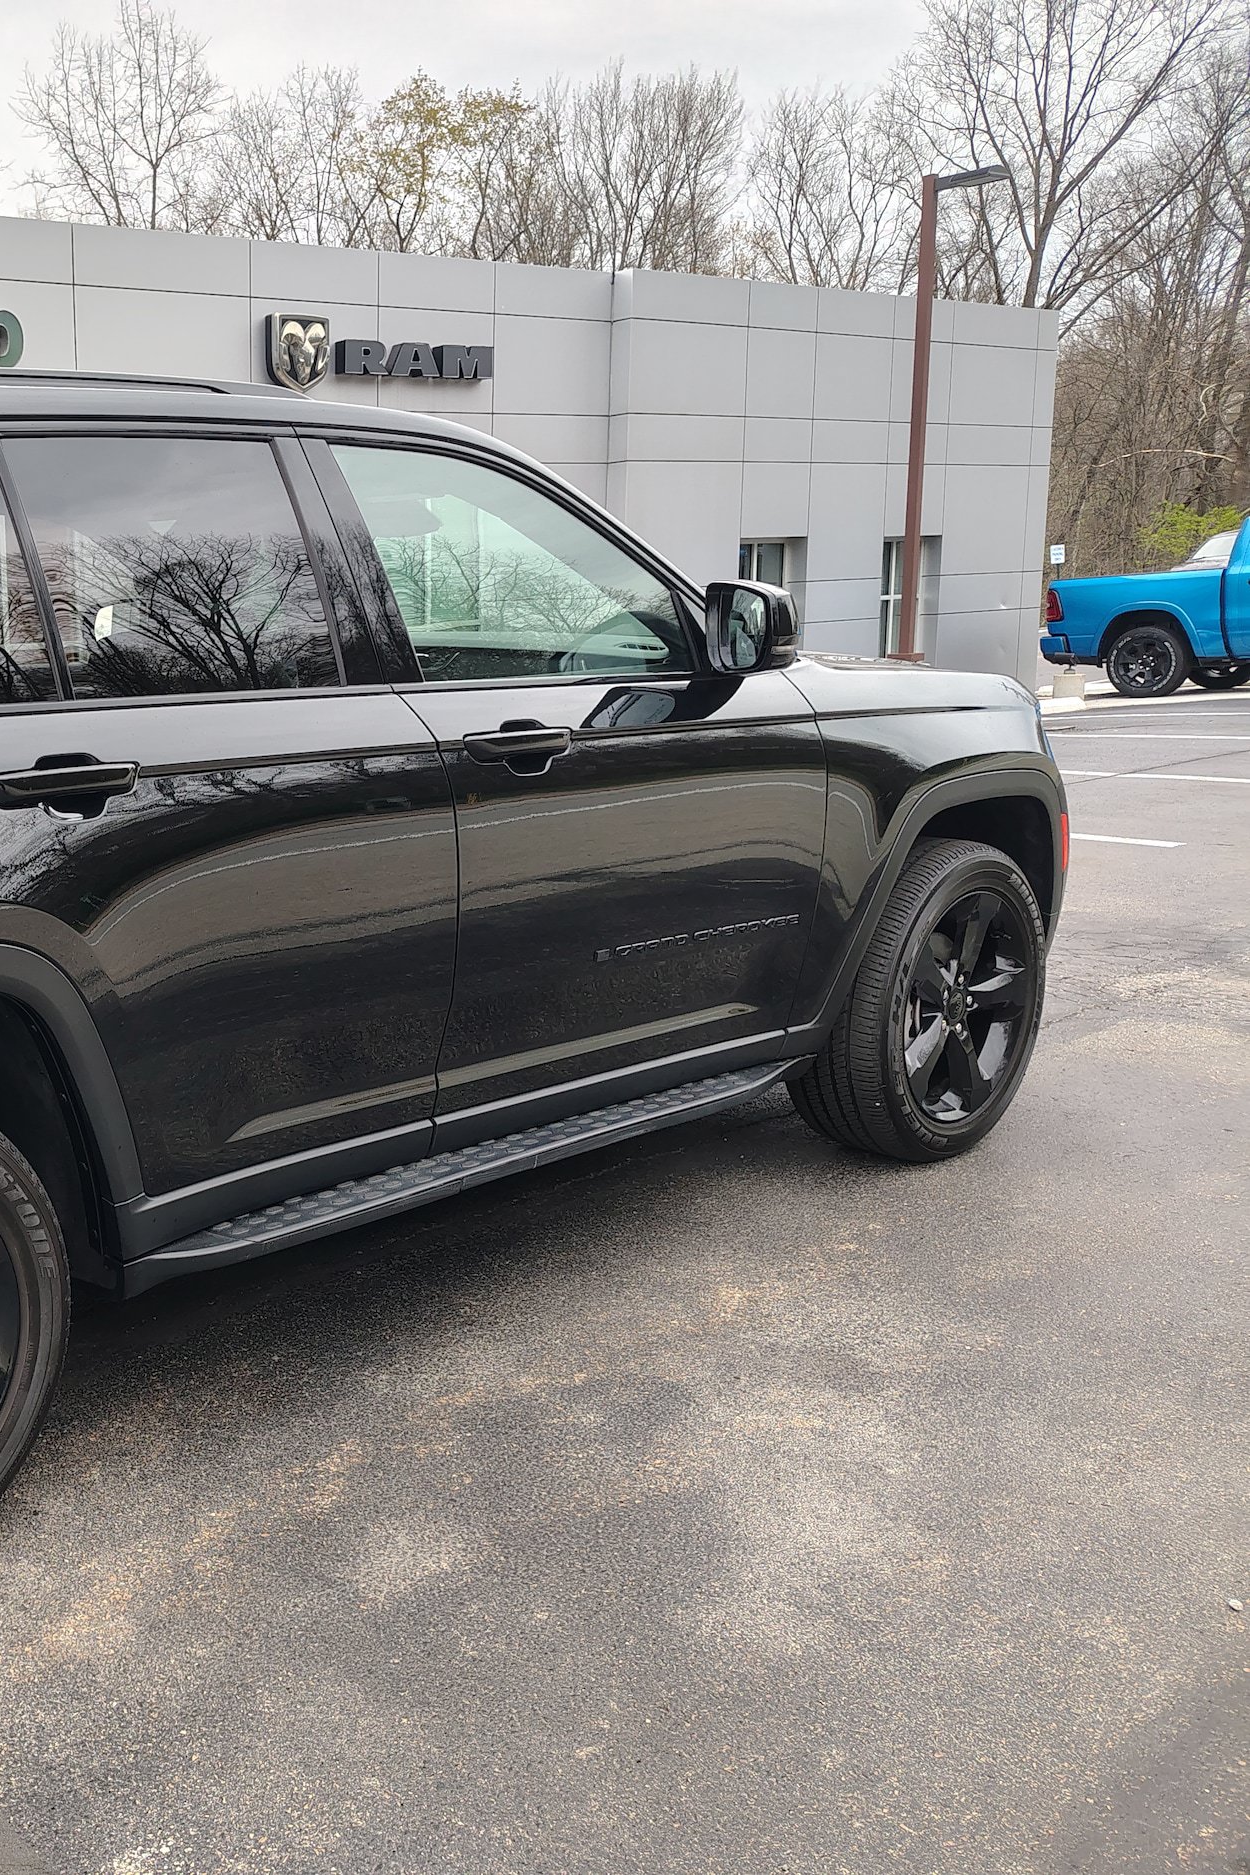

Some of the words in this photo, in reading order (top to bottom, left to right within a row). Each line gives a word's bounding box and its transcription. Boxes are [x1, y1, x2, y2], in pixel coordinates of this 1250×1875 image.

[334, 338, 494, 380] RAM
[614, 933, 689, 956] GRAND
[692, 913, 800, 942] CHEROKEE
